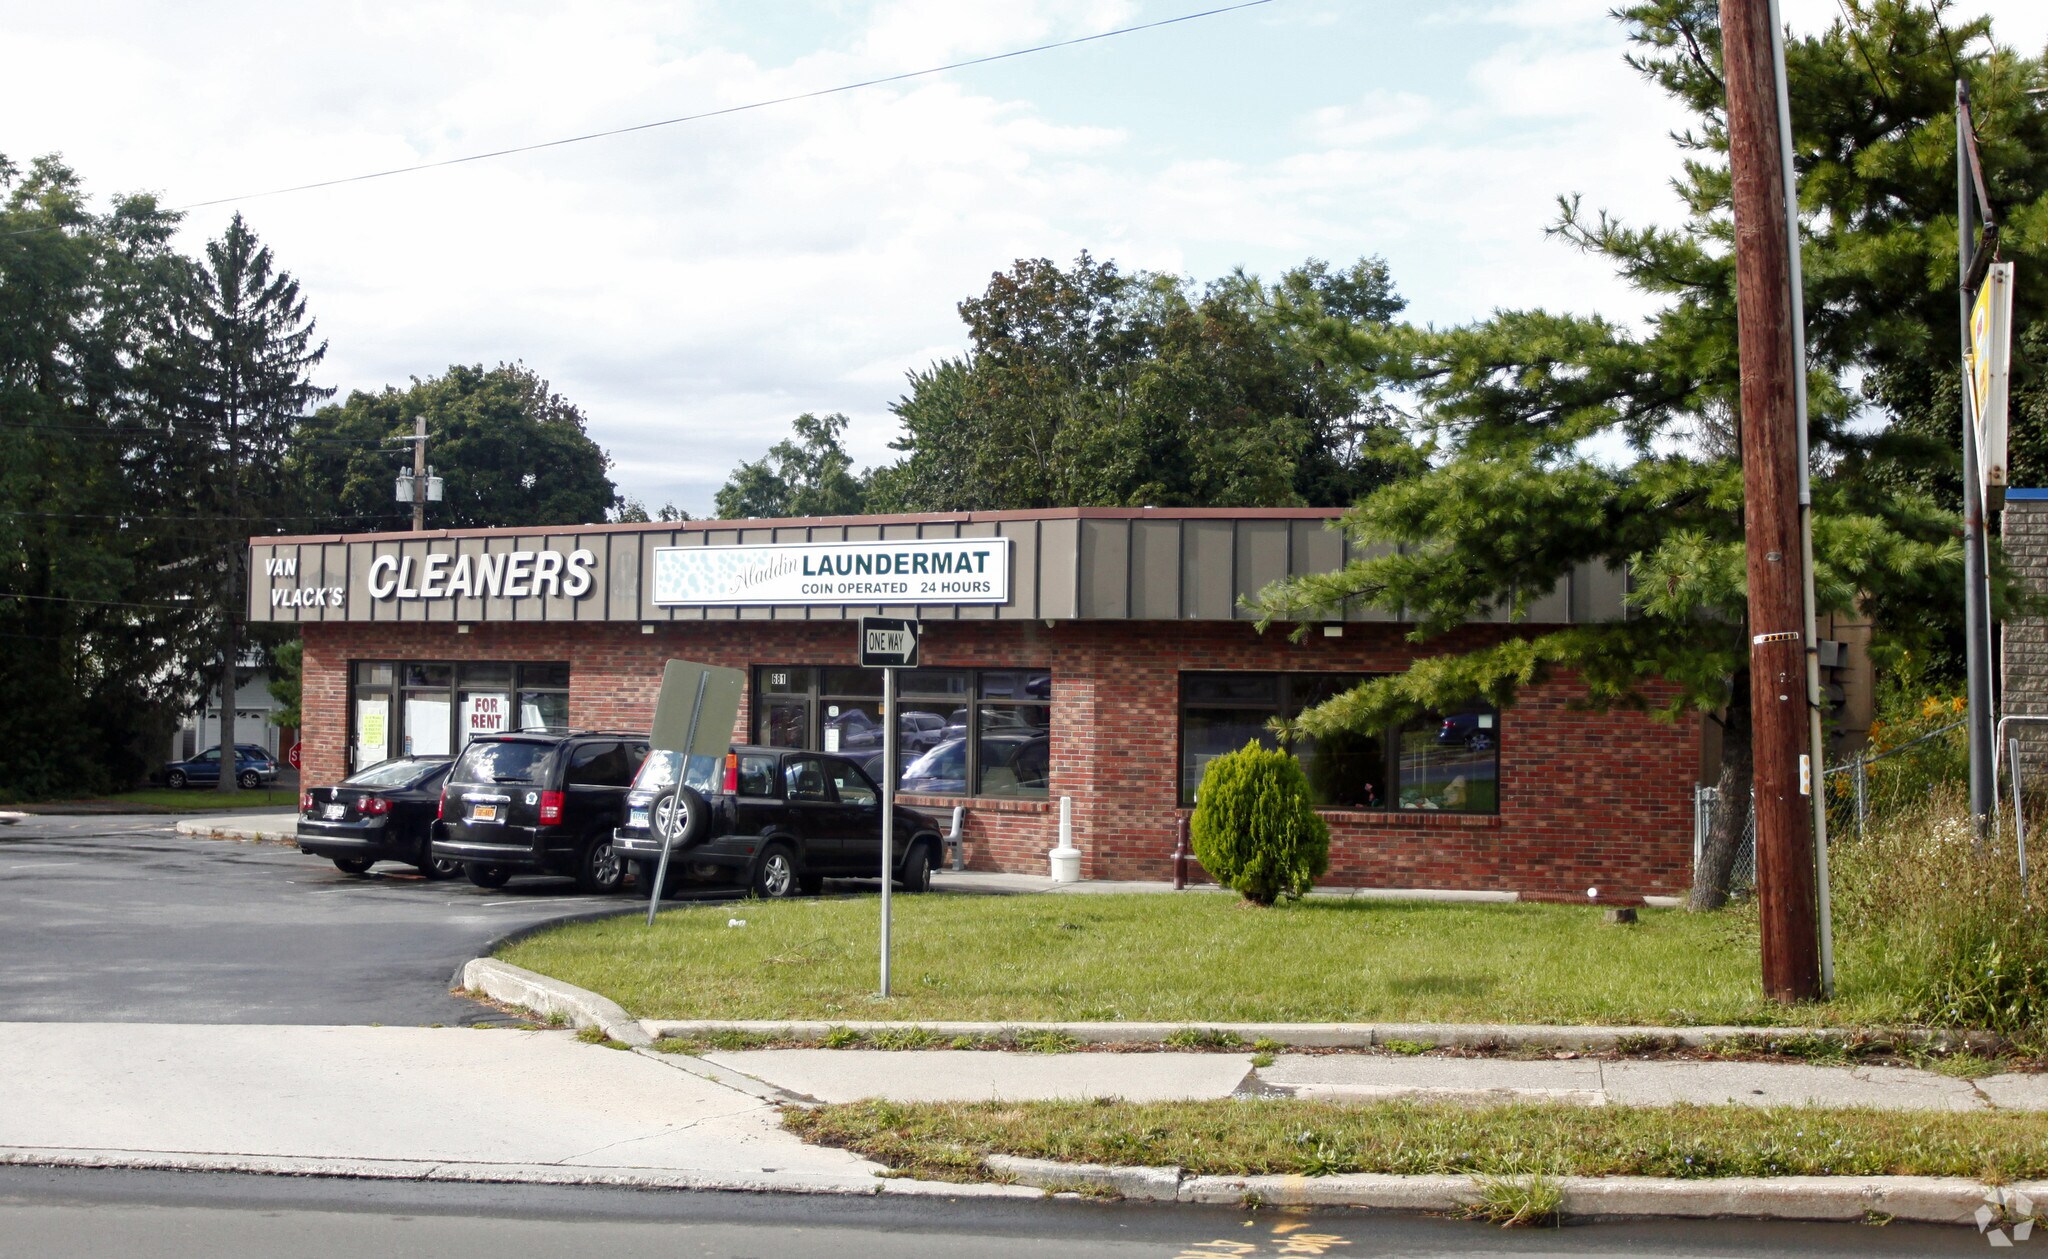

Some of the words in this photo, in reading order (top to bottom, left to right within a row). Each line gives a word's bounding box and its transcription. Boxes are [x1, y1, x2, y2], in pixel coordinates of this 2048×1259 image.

[265, 558, 297, 576] VAN
[802, 551, 990, 576] LAUNDERMAT
[368, 549, 596, 598] CLEANERS
[729, 553, 797, 594] Aladdin
[271, 587, 344, 606] VLACK'S
[801, 583, 833, 594] COIN
[837, 582, 908, 593] OPERATED
[920, 582, 936, 593] 24
[941, 581, 991, 592] HOURS
[869, 632, 885, 651] ONE
[887, 633, 904, 651] WAY
[772, 674, 786, 684] 681
[475, 697, 498, 713] FOR
[471, 714, 502, 729] RENT
